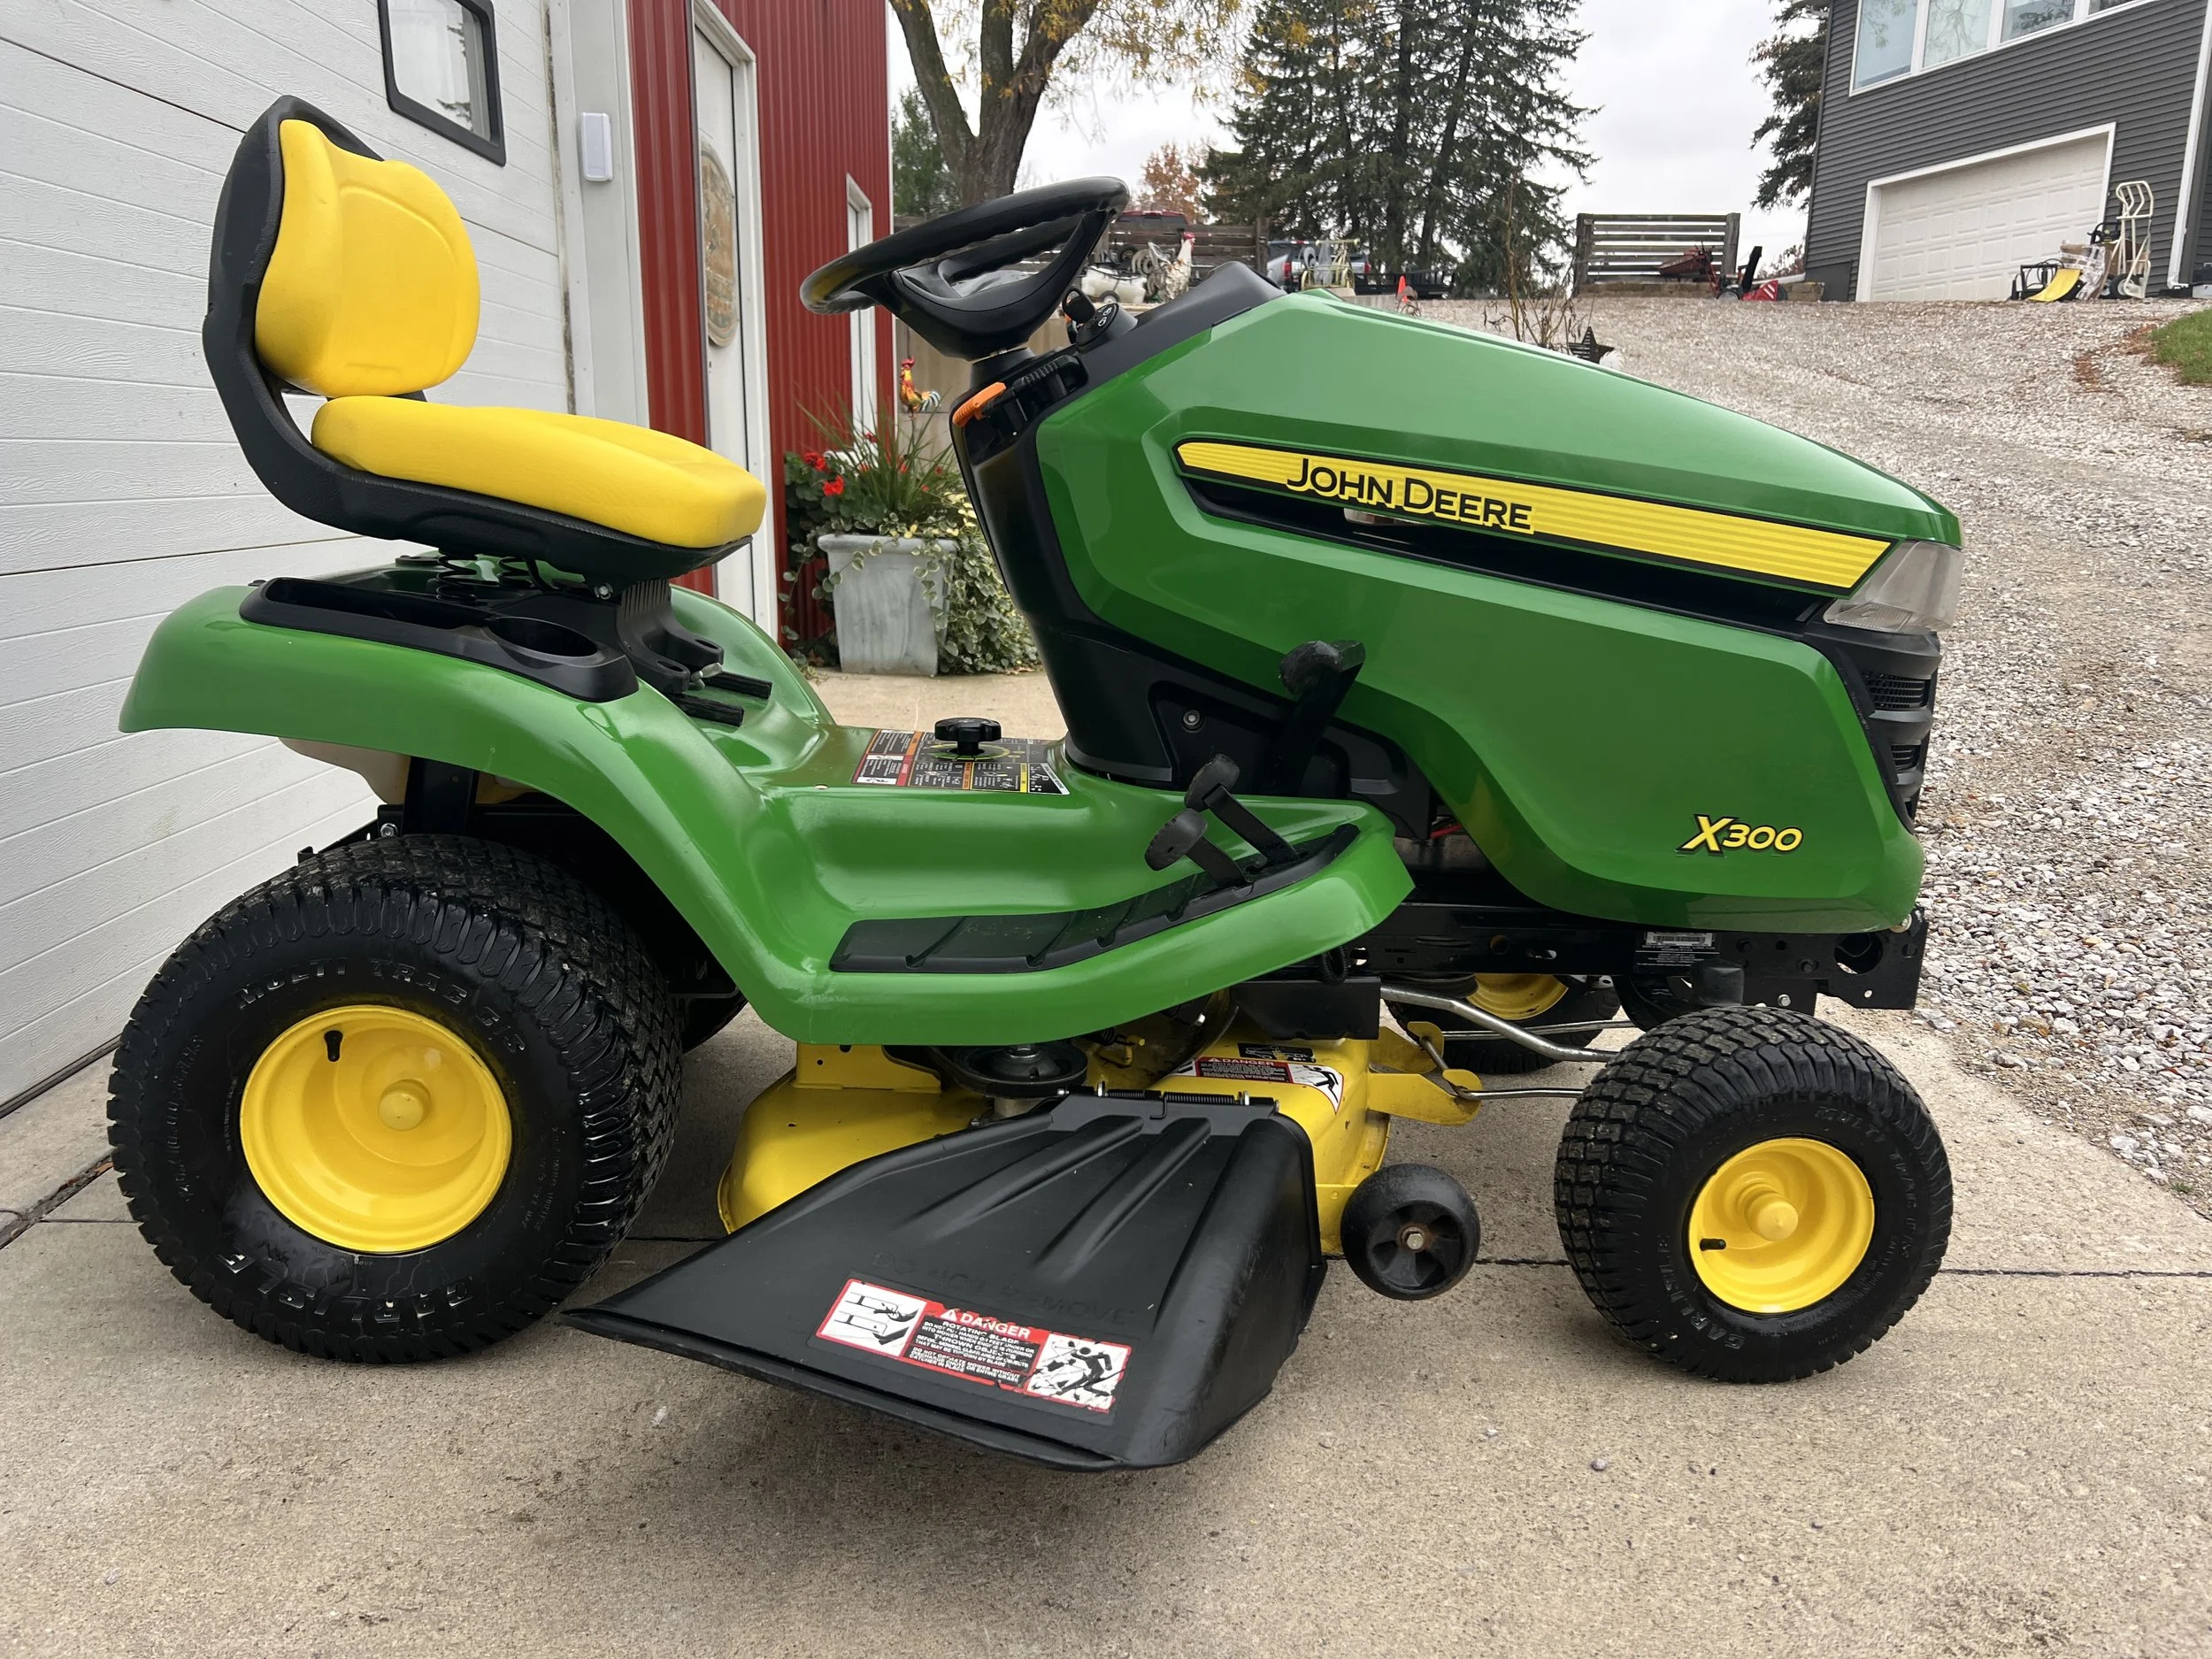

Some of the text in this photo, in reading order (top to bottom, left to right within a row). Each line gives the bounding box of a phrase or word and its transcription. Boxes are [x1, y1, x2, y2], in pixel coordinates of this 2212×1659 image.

[1286, 457, 1533, 530] JOHN DEERE
[1678, 814, 1804, 854] X300
[232, 956, 347, 1013] MULTI
[367, 956, 467, 1007] TRAC
[1222, 1058, 1275, 1067] DANGER
[215, 1246, 475, 1325] CARLISLE
[1656, 1234, 1747, 1351] CARLISLE
[917, 1334, 938, 1343] BEFOR
[958, 1331, 979, 1340] HANDS
[960, 1313, 1031, 1339] DANGER
[936, 1329, 958, 1339] MOWER
[977, 1341, 999, 1350] ENGE
[974, 1345, 1017, 1359] OBJES
